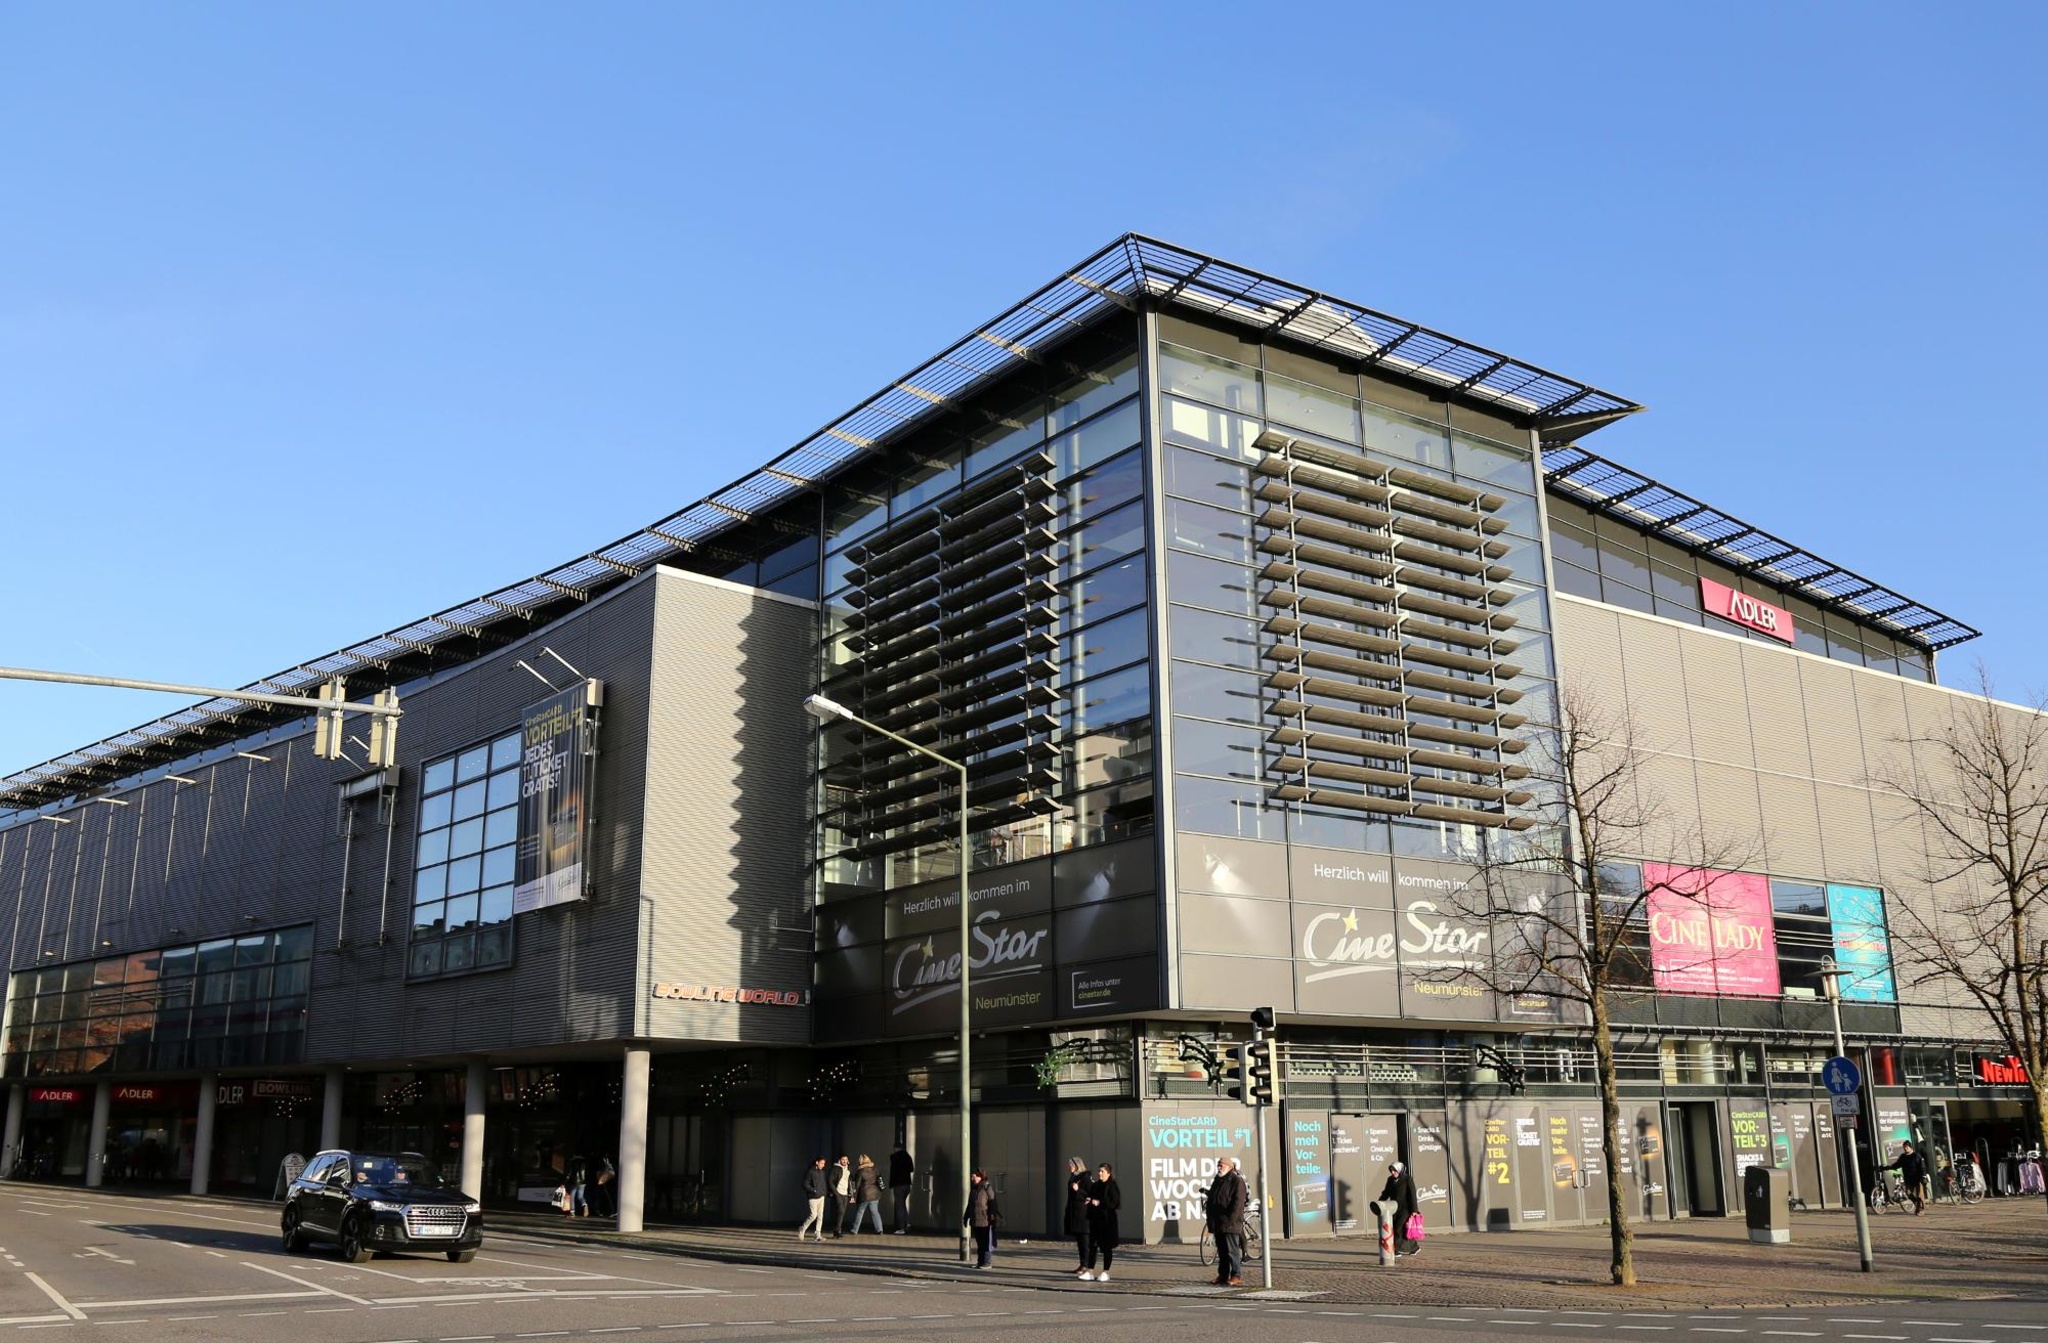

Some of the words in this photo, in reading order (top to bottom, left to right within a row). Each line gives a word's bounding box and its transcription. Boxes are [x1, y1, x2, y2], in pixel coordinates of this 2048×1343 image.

[1731, 589, 1778, 631] ADLER
[525, 713, 571, 747] VORTEIL
[524, 739, 553, 766] JEDES
[533, 751, 568, 779] TICKET
[1313, 863, 1365, 882] Herzlich
[1453, 878, 1469, 891] im
[903, 896, 941, 916] Herzlich
[1016, 878, 1030, 893] im
[1652, 912, 1709, 947] CINE
[1714, 918, 1765, 951] LADY
[653, 983, 737, 1002] BOWLING
[737, 988, 800, 1006] WORLD
[1413, 981, 1485, 997] Neumünster
[975, 991, 1041, 1010] Neumünster
[40, 1090, 73, 1100] ADLER
[119, 1088, 153, 1099] ADLER
[217, 1086, 244, 1105] DLER
[1149, 1116, 1217, 1126] CineStarCARD
[1294, 1121, 1321, 1132] Noch
[1732, 1120, 1760, 1133] VOR-
[1149, 1129, 1233, 1148] VORTEIL
[1486, 1134, 1510, 1144] VOR-
[1295, 1149, 1316, 1160] Vor-
[1487, 1148, 1507, 1158] TEIL
[1151, 1158, 1197, 1178] FILM
[1296, 1163, 1321, 1174] teile:
[1488, 1161, 1510, 1184] #2
[1150, 1179, 1216, 1199] WOCH
[1151, 1201, 1181, 1221] AB
